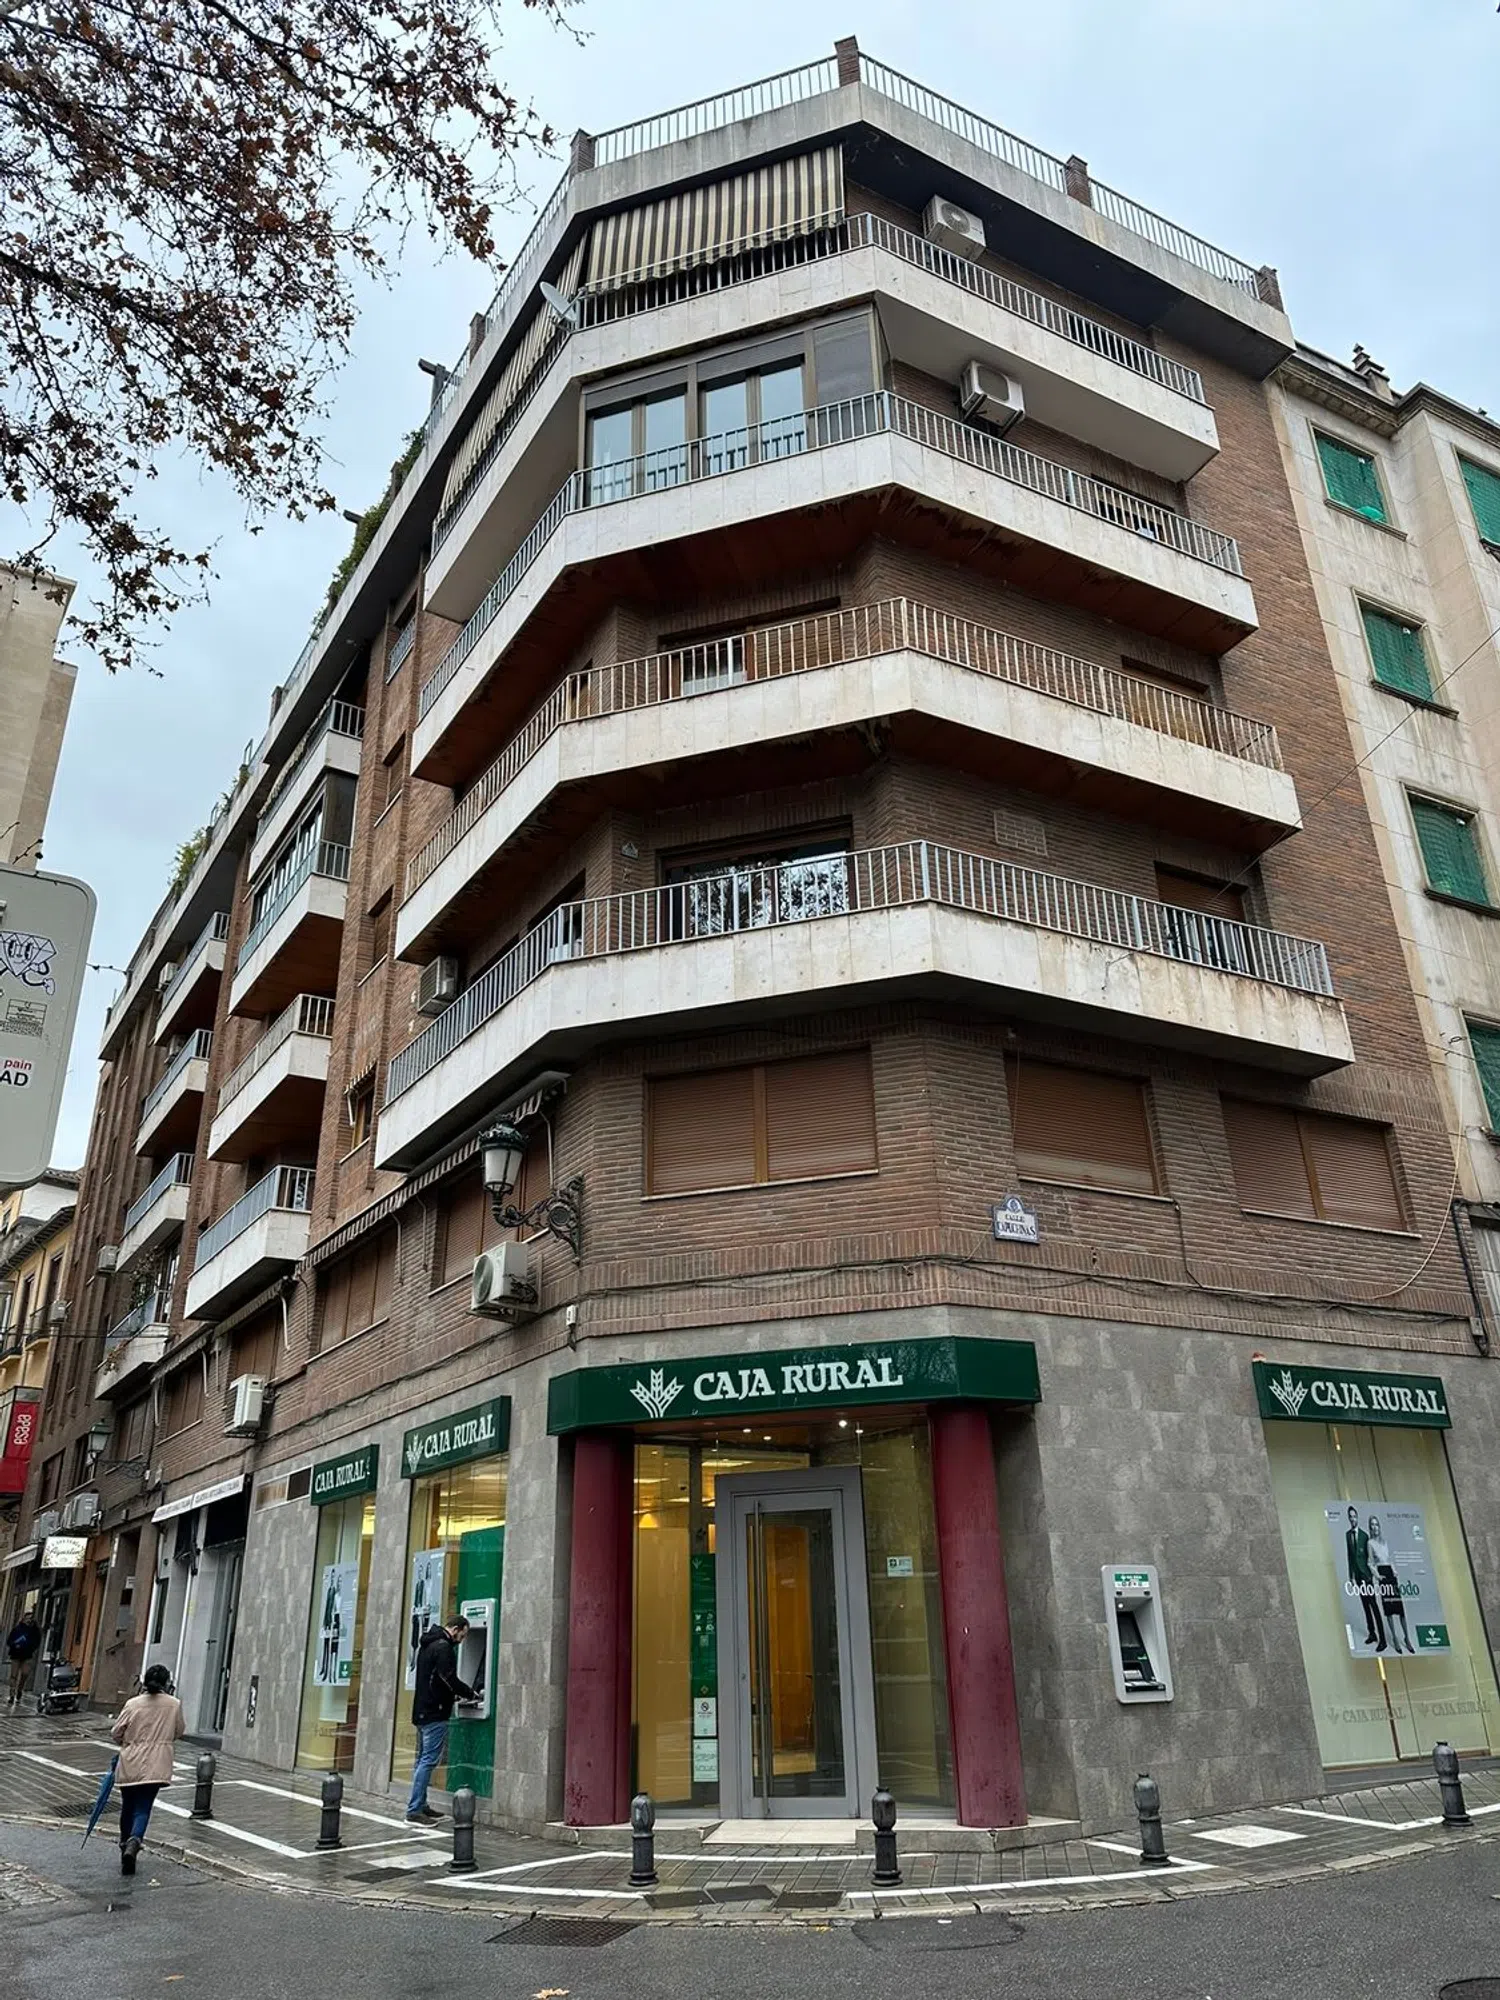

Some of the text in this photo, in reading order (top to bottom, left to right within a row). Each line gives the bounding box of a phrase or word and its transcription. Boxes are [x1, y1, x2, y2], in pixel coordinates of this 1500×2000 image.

[4, 1059, 32, 1071] pain
[693, 1357, 904, 1401] CAJA RURAL
[1310, 1380, 1447, 1415] CAJA RURAL
[424, 1413, 496, 1459] CAJA RURAL
[314, 1459, 366, 1494] CAJA RURAL
